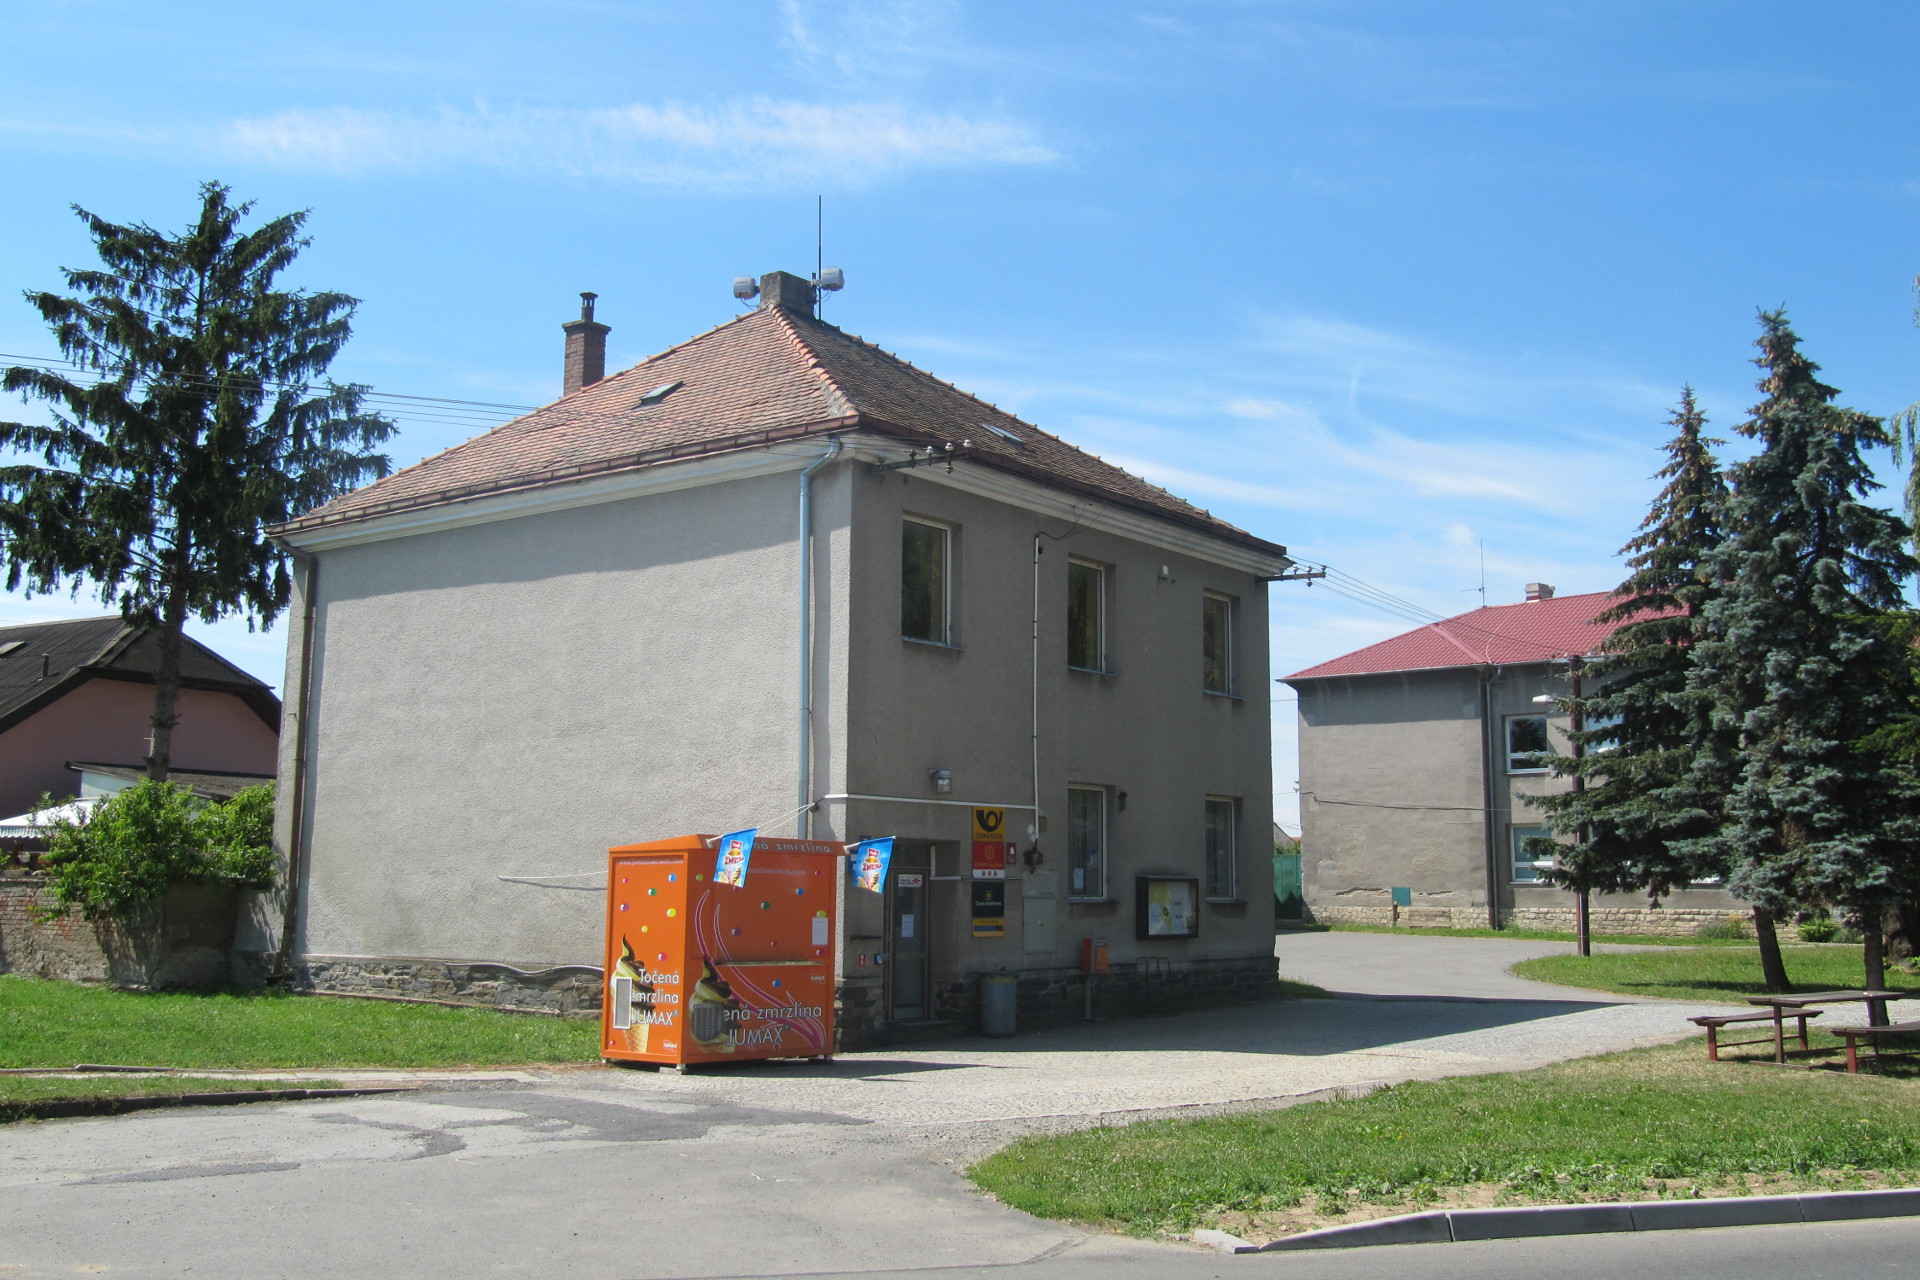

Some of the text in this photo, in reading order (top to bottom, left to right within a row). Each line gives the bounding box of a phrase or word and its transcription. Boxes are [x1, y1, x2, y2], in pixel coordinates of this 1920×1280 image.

[776, 842, 831, 853] zmrzlina
[638, 968, 680, 984] Točená
[631, 988, 679, 1004] zmrzlina
[756, 1000, 823, 1020] zmrzlina
